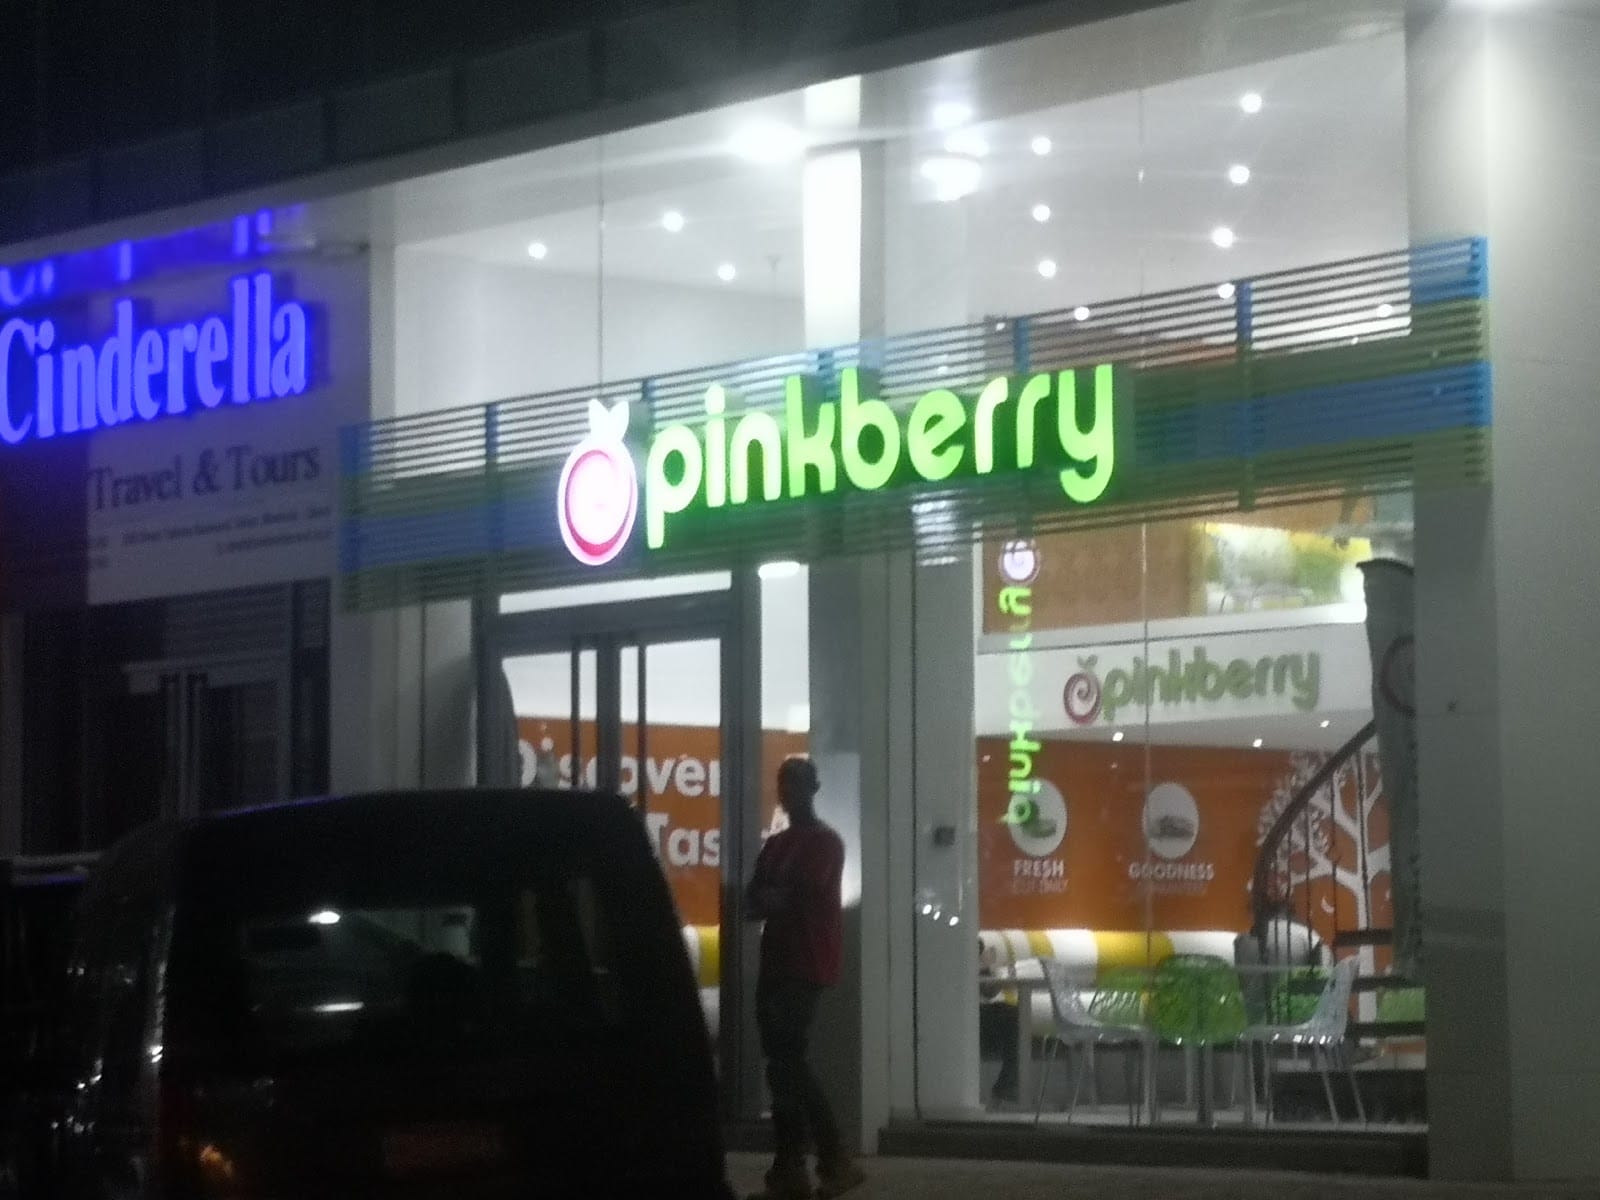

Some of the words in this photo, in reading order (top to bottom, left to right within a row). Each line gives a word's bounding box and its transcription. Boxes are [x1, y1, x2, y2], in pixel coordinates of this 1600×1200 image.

[0, 271, 308, 445] Cinderella
[88, 454, 182, 511] Travel
[193, 448, 222, 496] &
[227, 444, 321, 491] Tours
[645, 363, 1115, 549] pinkberry
[1101, 646, 1321, 722] pinkberry
[1013, 859, 1065, 878] FRESH
